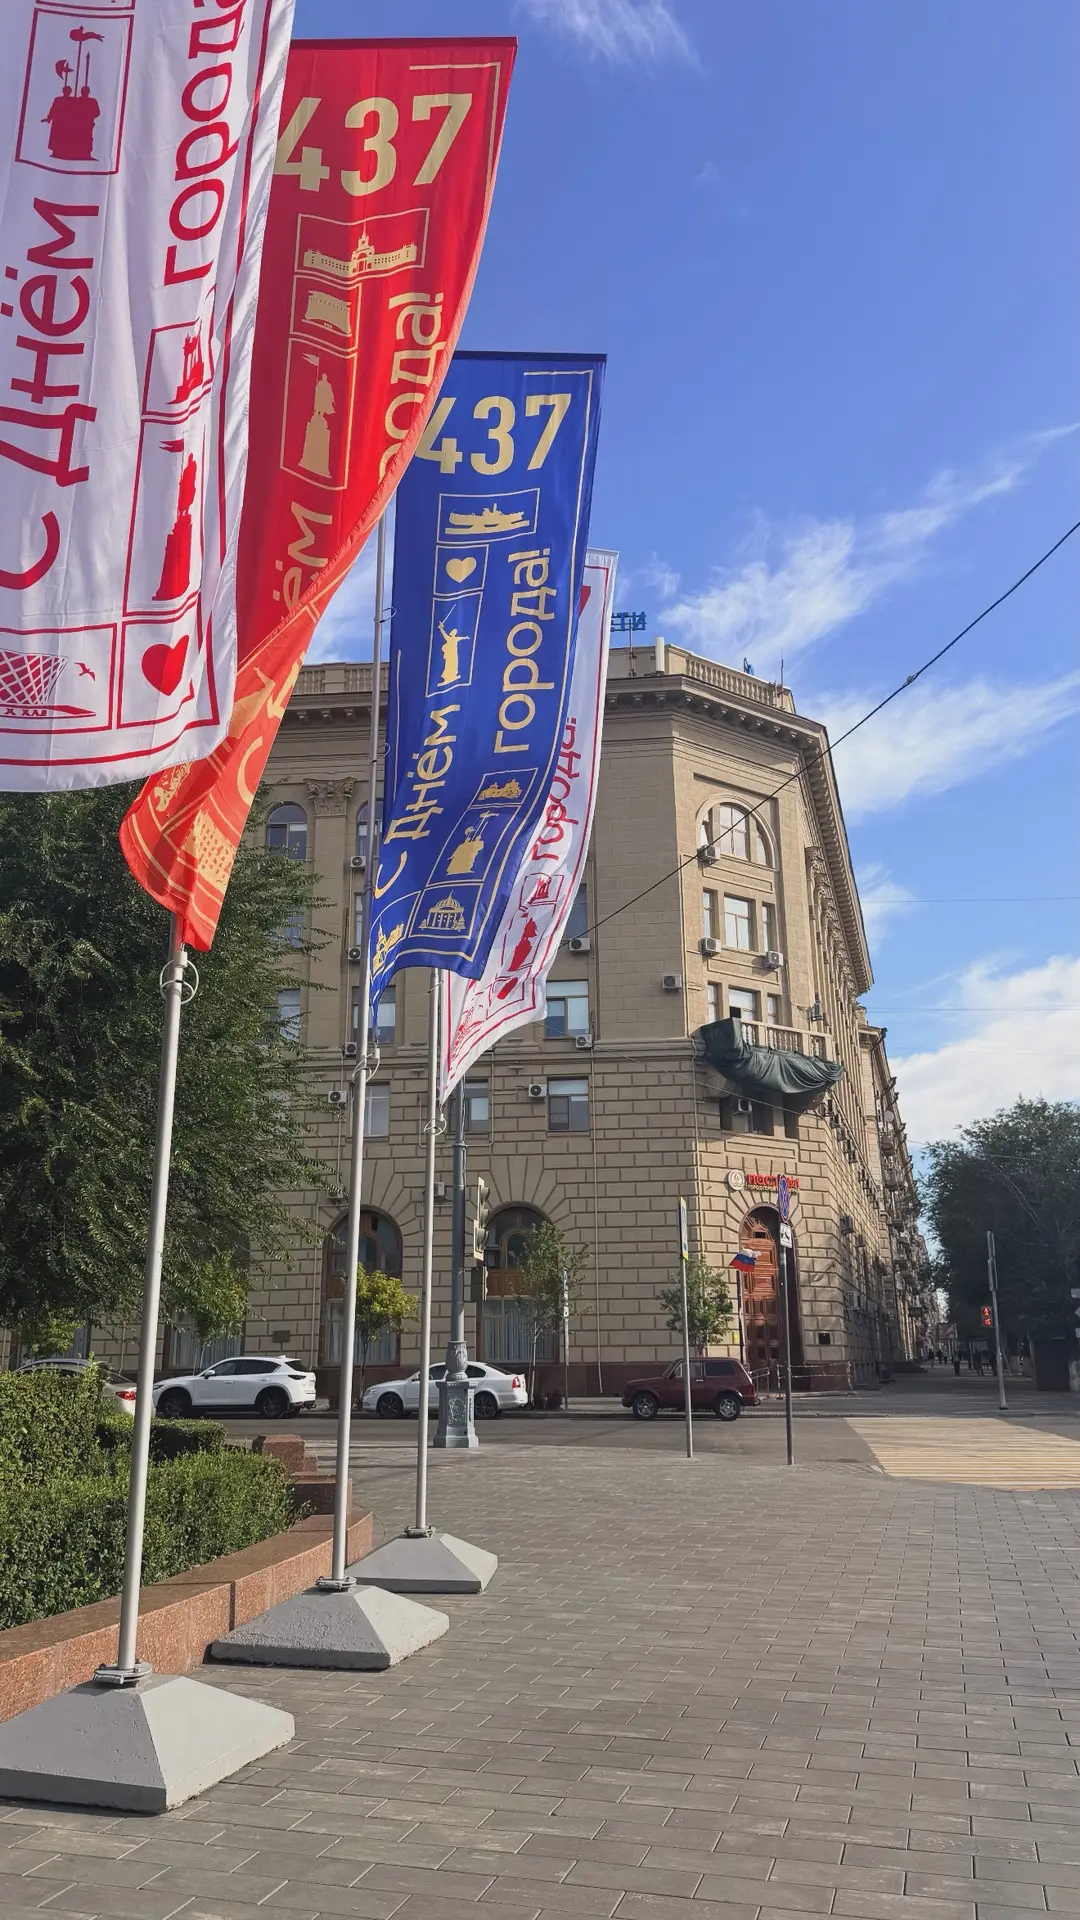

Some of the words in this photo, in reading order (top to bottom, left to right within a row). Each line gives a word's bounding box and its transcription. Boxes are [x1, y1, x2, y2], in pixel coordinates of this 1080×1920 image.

[274, 93, 473, 195] 437
[0, 197, 100, 488] Днём
[378, 292, 447, 485] ода!
[413, 393, 572, 475] 437
[494, 547, 557, 753] города!
[385, 704, 461, 841] Днём
